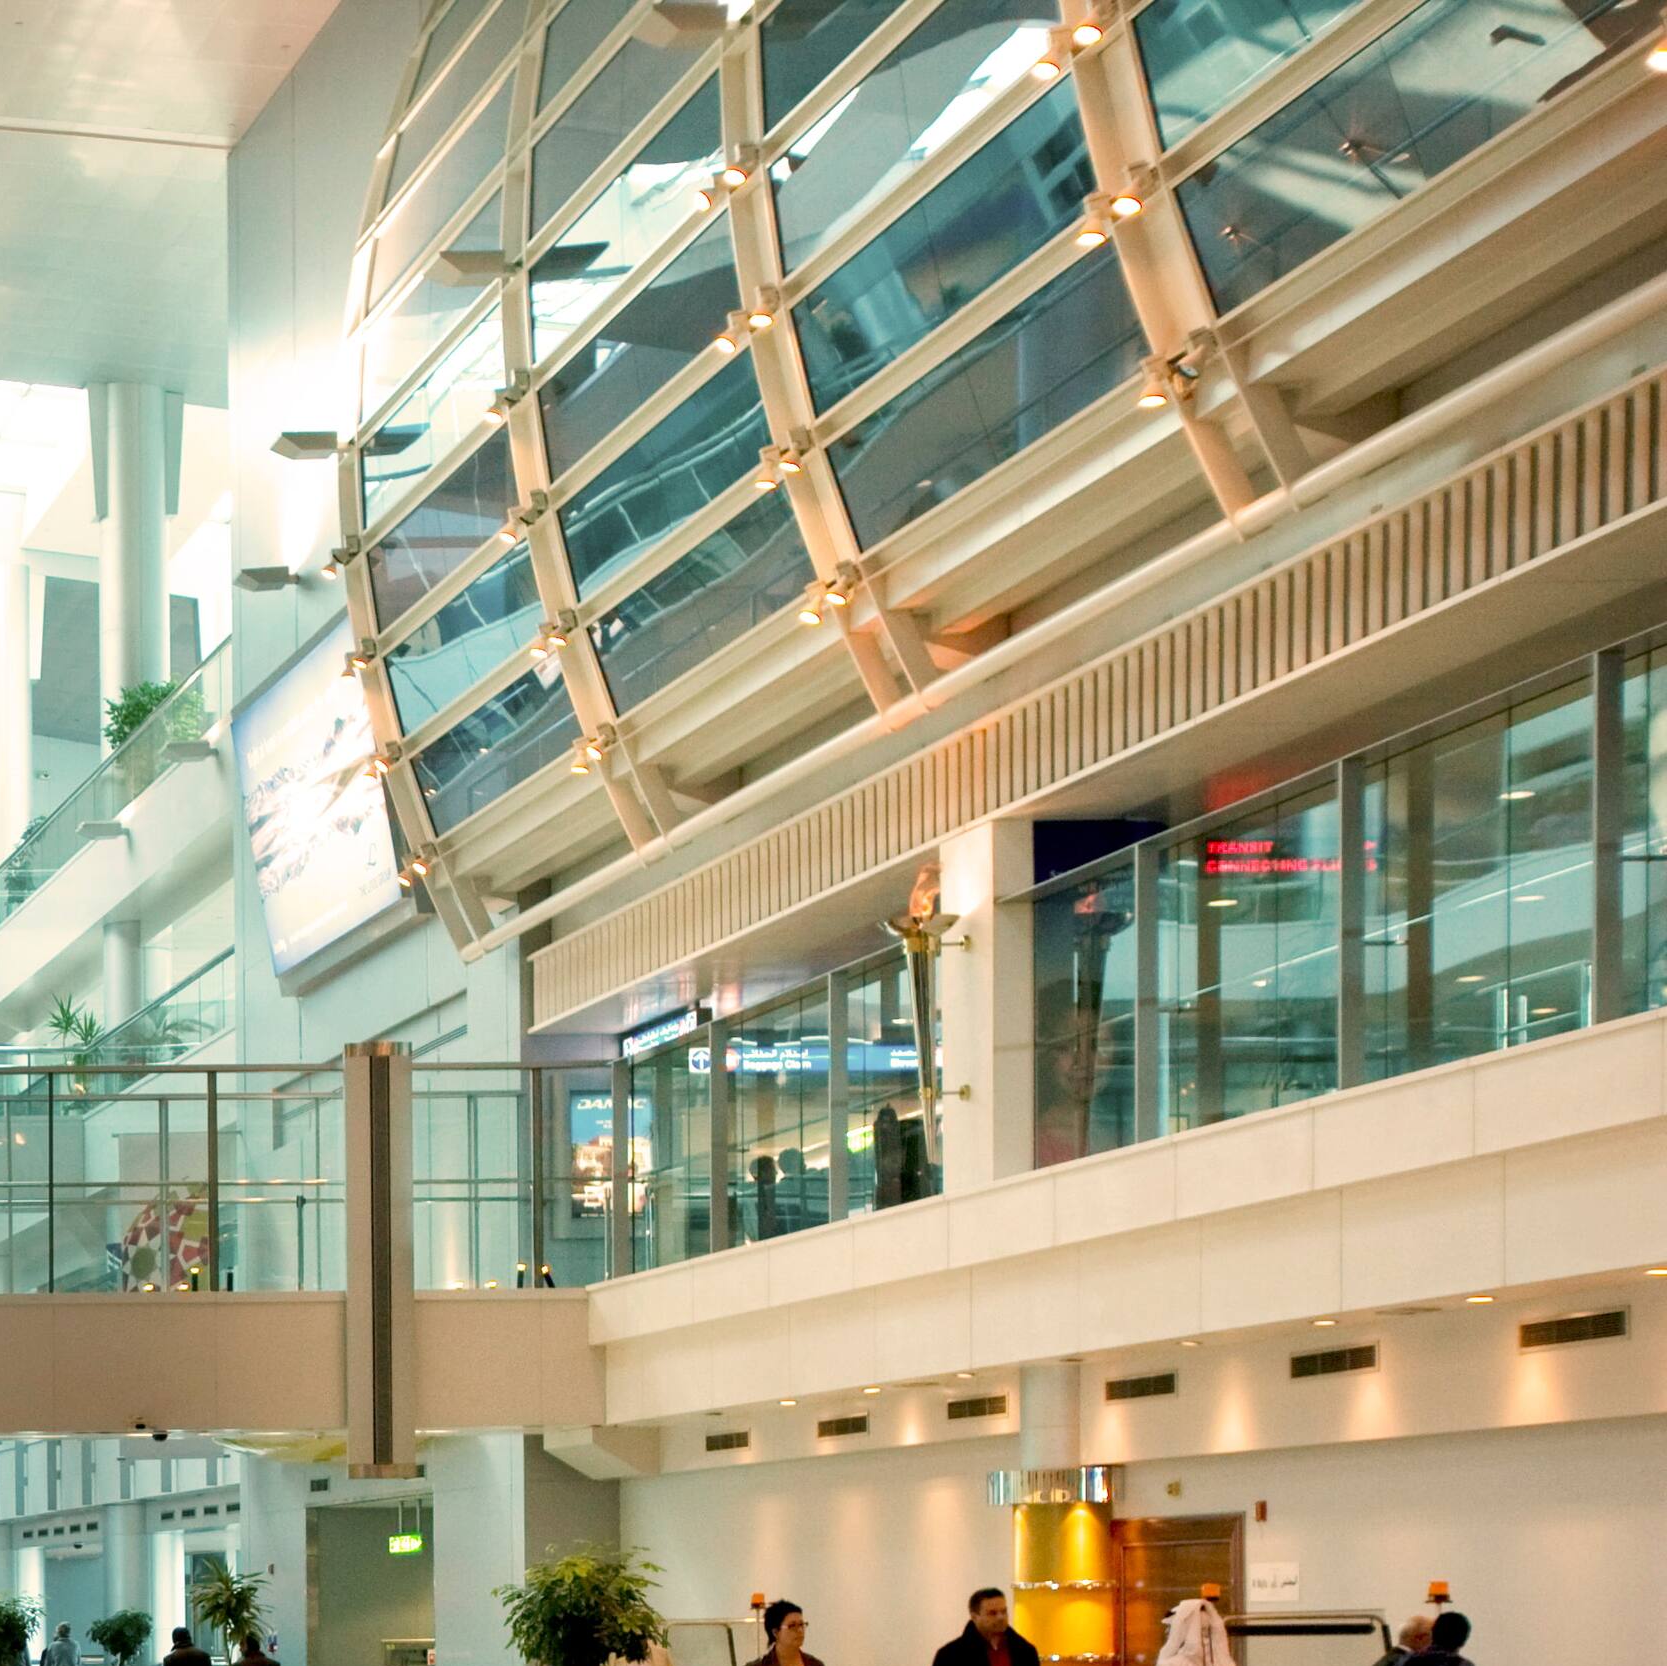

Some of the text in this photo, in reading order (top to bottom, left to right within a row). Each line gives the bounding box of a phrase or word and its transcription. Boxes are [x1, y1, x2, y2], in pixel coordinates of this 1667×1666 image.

[1207, 841, 1274, 855] TRANSIT
[1205, 859, 1308, 873] CONNECTING
[577, 1098, 648, 1111] DAMC
